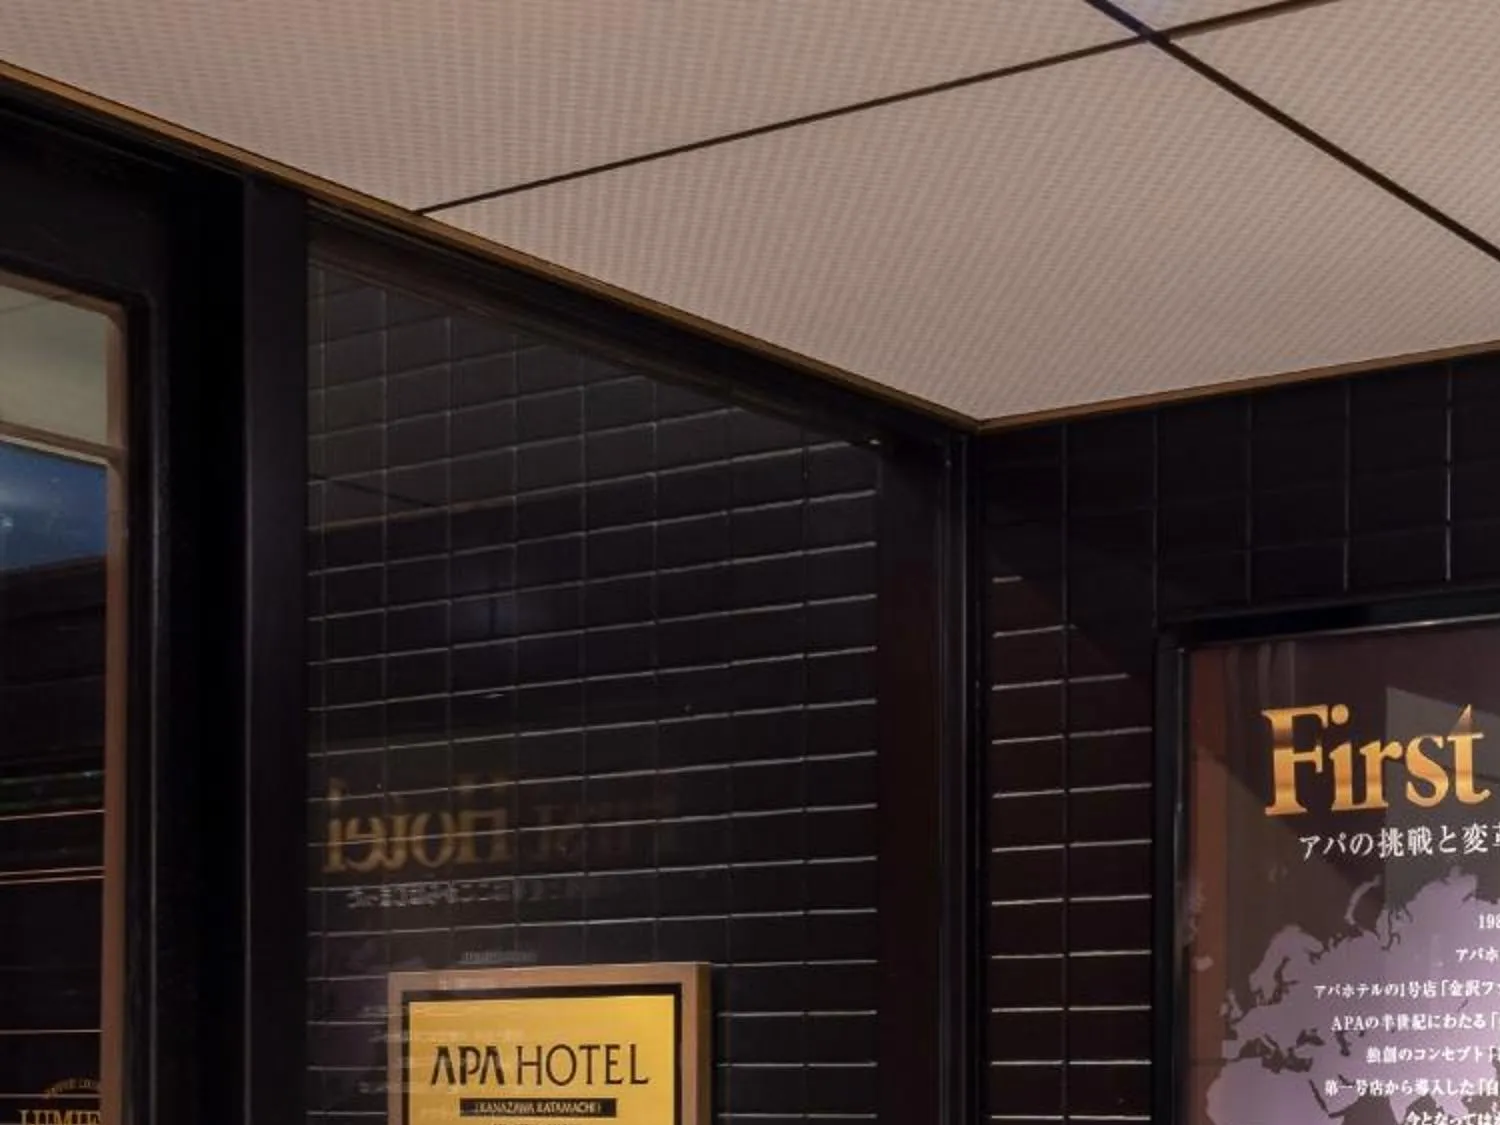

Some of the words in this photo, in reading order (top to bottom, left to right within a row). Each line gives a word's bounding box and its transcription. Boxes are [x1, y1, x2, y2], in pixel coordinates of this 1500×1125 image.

[1261, 703, 1491, 816] First
[431, 1045, 505, 1086] APA
[516, 1043, 650, 1086] HOTEL
